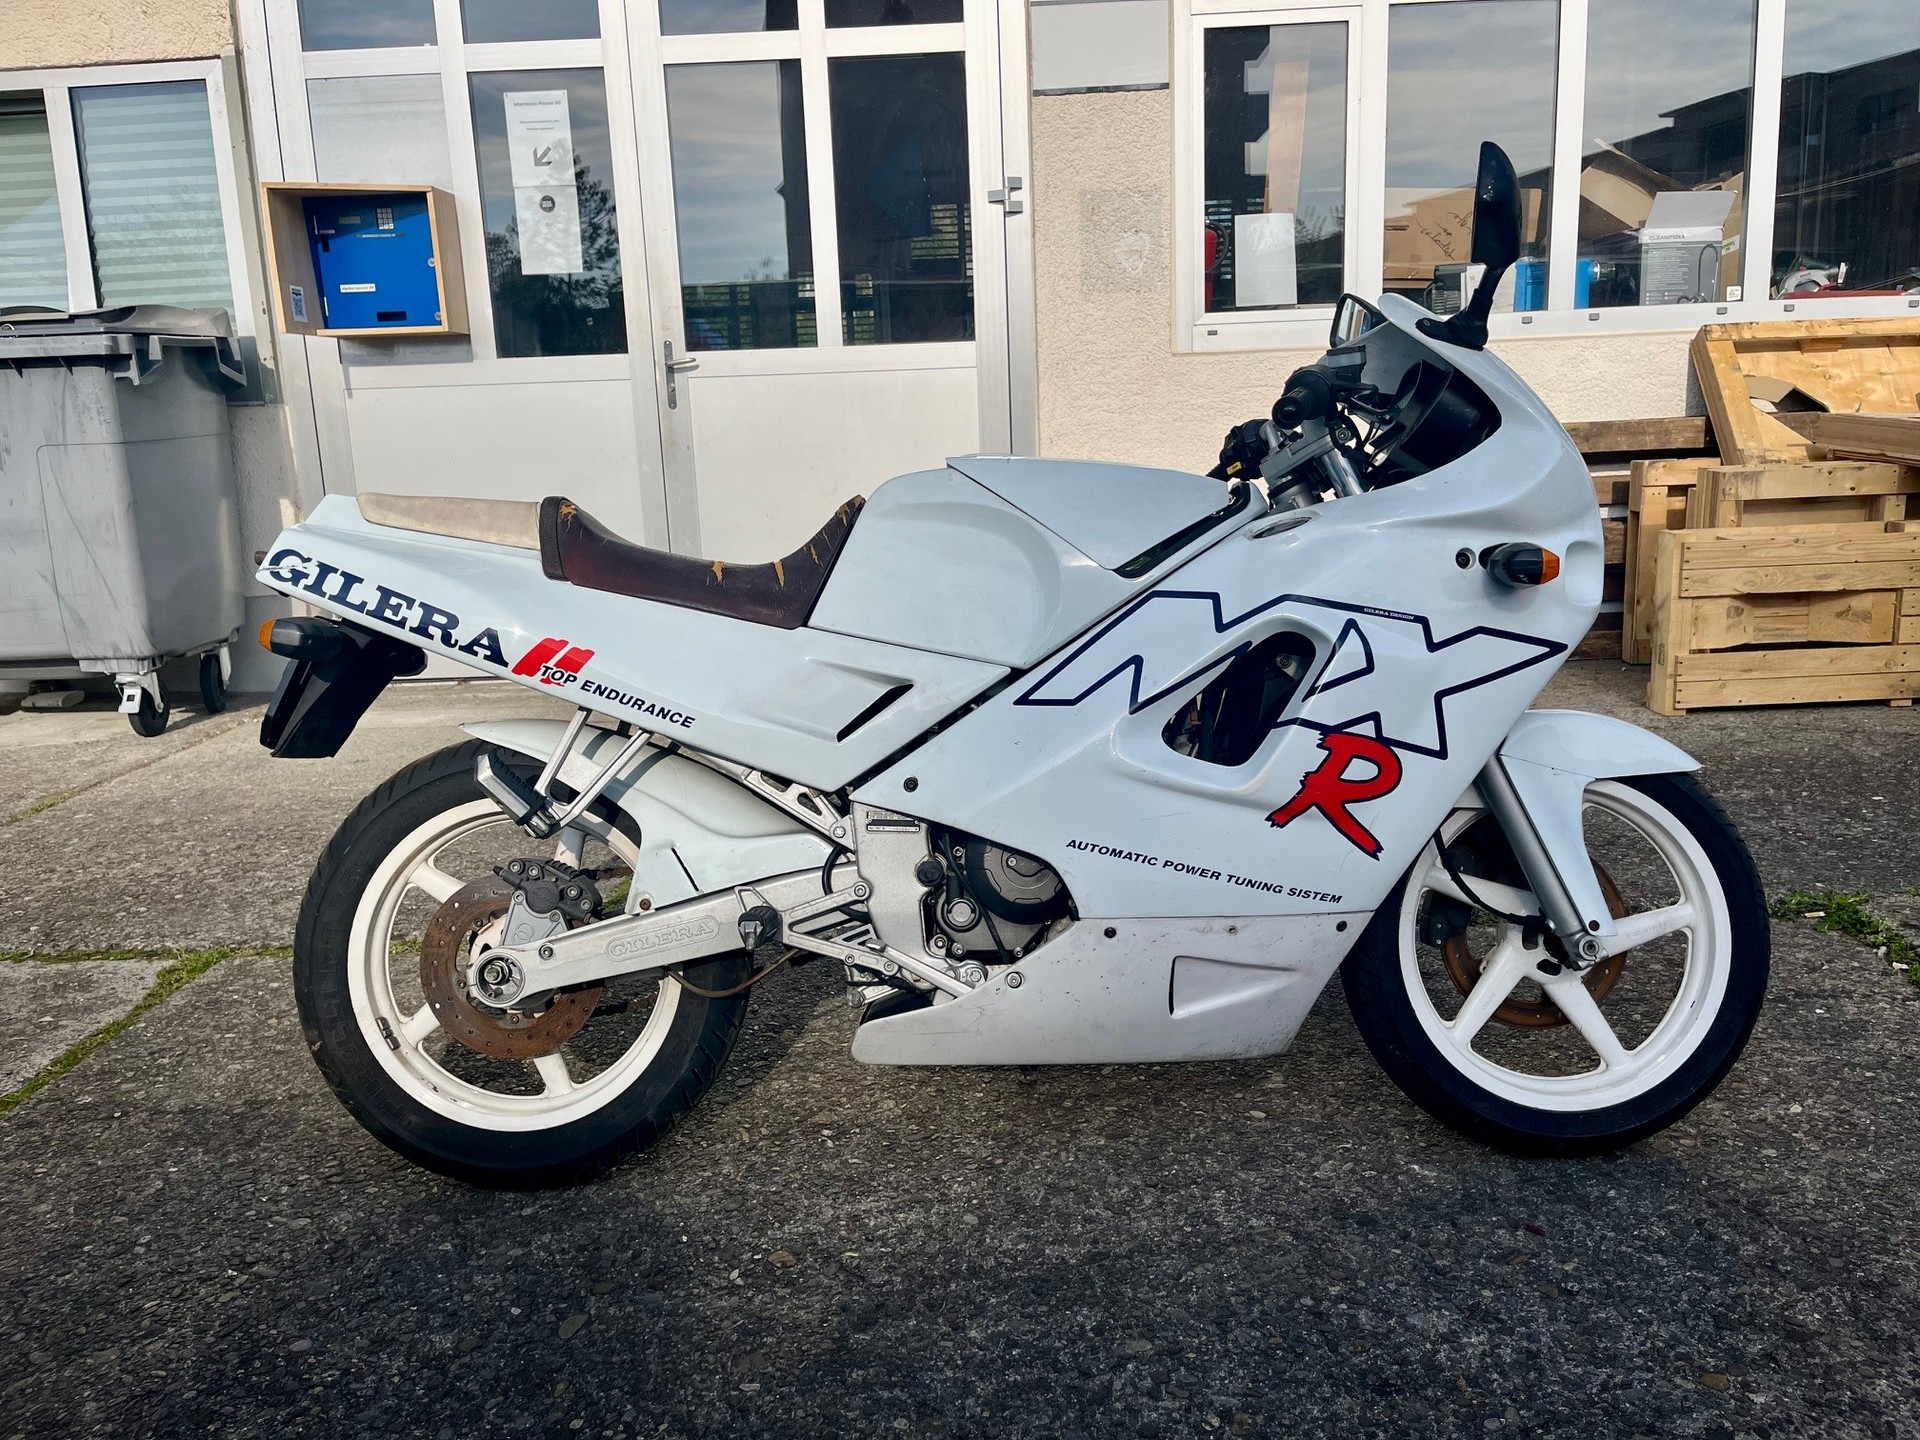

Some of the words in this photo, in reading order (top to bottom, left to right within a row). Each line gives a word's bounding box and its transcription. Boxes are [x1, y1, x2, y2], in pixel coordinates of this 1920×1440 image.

[268, 548, 510, 668] GILERA
[1364, 607, 1389, 616] GILERA
[1390, 612, 1415, 620] DESIGN
[541, 664, 578, 688] TOP
[581, 679, 696, 730] ENDURANCE
[1265, 731, 1403, 861] R
[1066, 839, 1159, 866] AUTOMATIC
[1163, 860, 1222, 882] POWER
[1226, 874, 1284, 895] TUNING
[1286, 887, 1343, 905] SISTEM
[610, 920, 714, 958] GILERA
